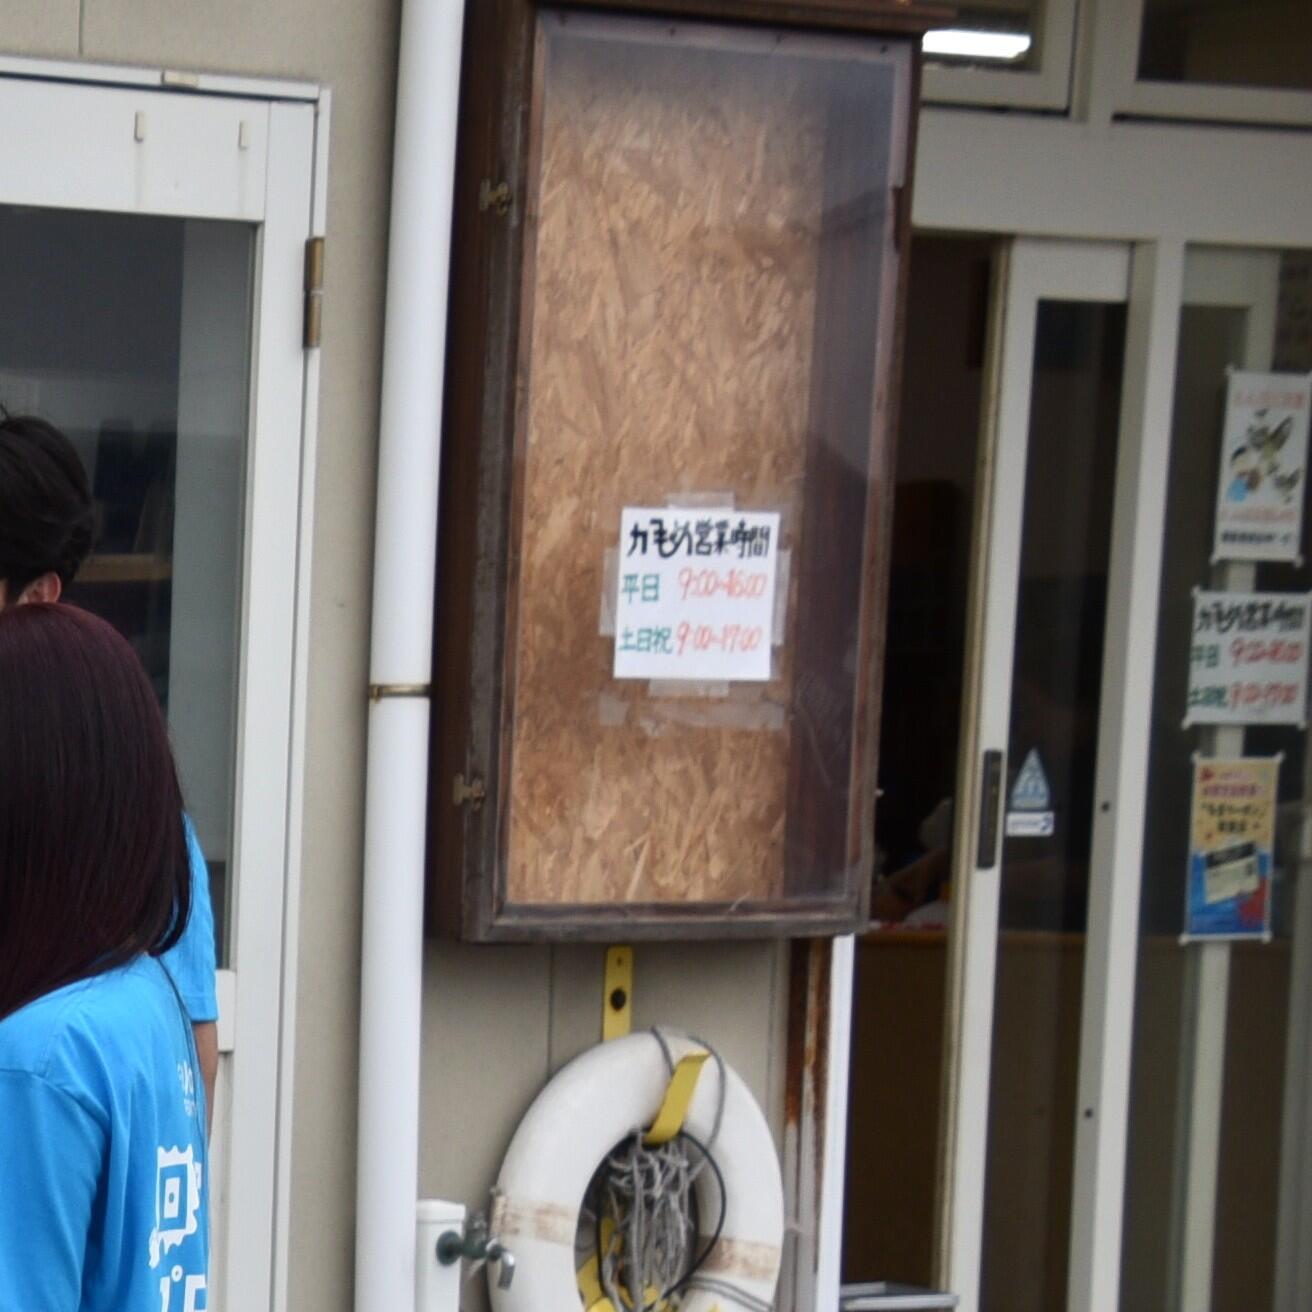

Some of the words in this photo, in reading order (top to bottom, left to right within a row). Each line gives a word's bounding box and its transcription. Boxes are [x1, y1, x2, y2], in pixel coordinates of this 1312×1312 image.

[621, 573, 660, 604] 平日
[619, 625, 673, 654] 土日祝
